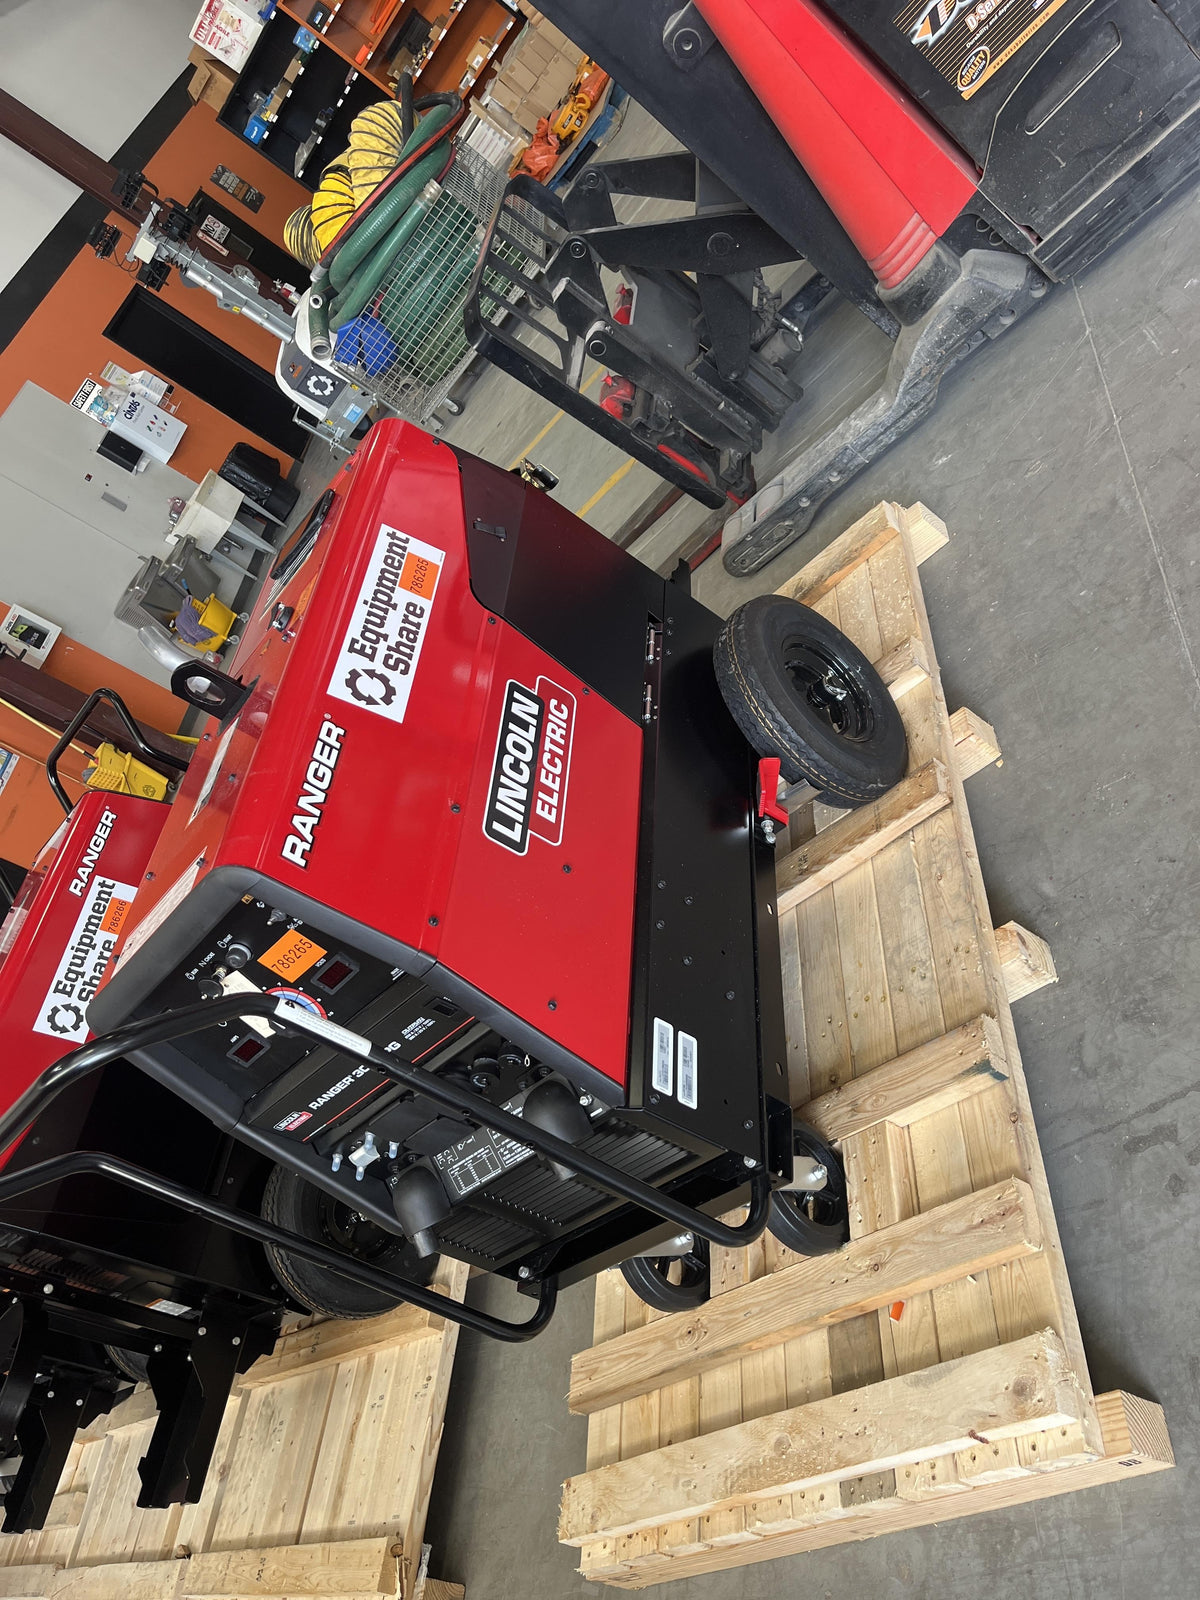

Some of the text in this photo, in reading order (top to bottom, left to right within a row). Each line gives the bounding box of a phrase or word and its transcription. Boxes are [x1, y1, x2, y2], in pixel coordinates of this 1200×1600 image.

[966, 25, 989, 48] Durability
[988, 14, 999, 26] and
[961, 56, 976, 75] BECAUSE
[961, 50, 987, 86] QUALITY
[972, 60, 986, 79] MATTERS
[73, 390, 88, 409] SAFETY
[81, 380, 96, 395] FIRST
[123, 399, 140, 420] CINTAS
[408, 557, 430, 594] 786265
[347, 530, 410, 662] Equipment
[382, 602, 425, 676] Share
[491, 688, 544, 844] LINCOLN
[536, 697, 570, 824] ELECTRIC
[281, 721, 346, 868] RANGER
[68, 809, 117, 898] RANGER
[107, 900, 128, 933] 786266
[52, 879, 116, 998] Equipment
[272, 938, 313, 974] 786265
[308, 1075, 355, 1110] RANGER
[275, 1111, 300, 1131] LINCOLN
